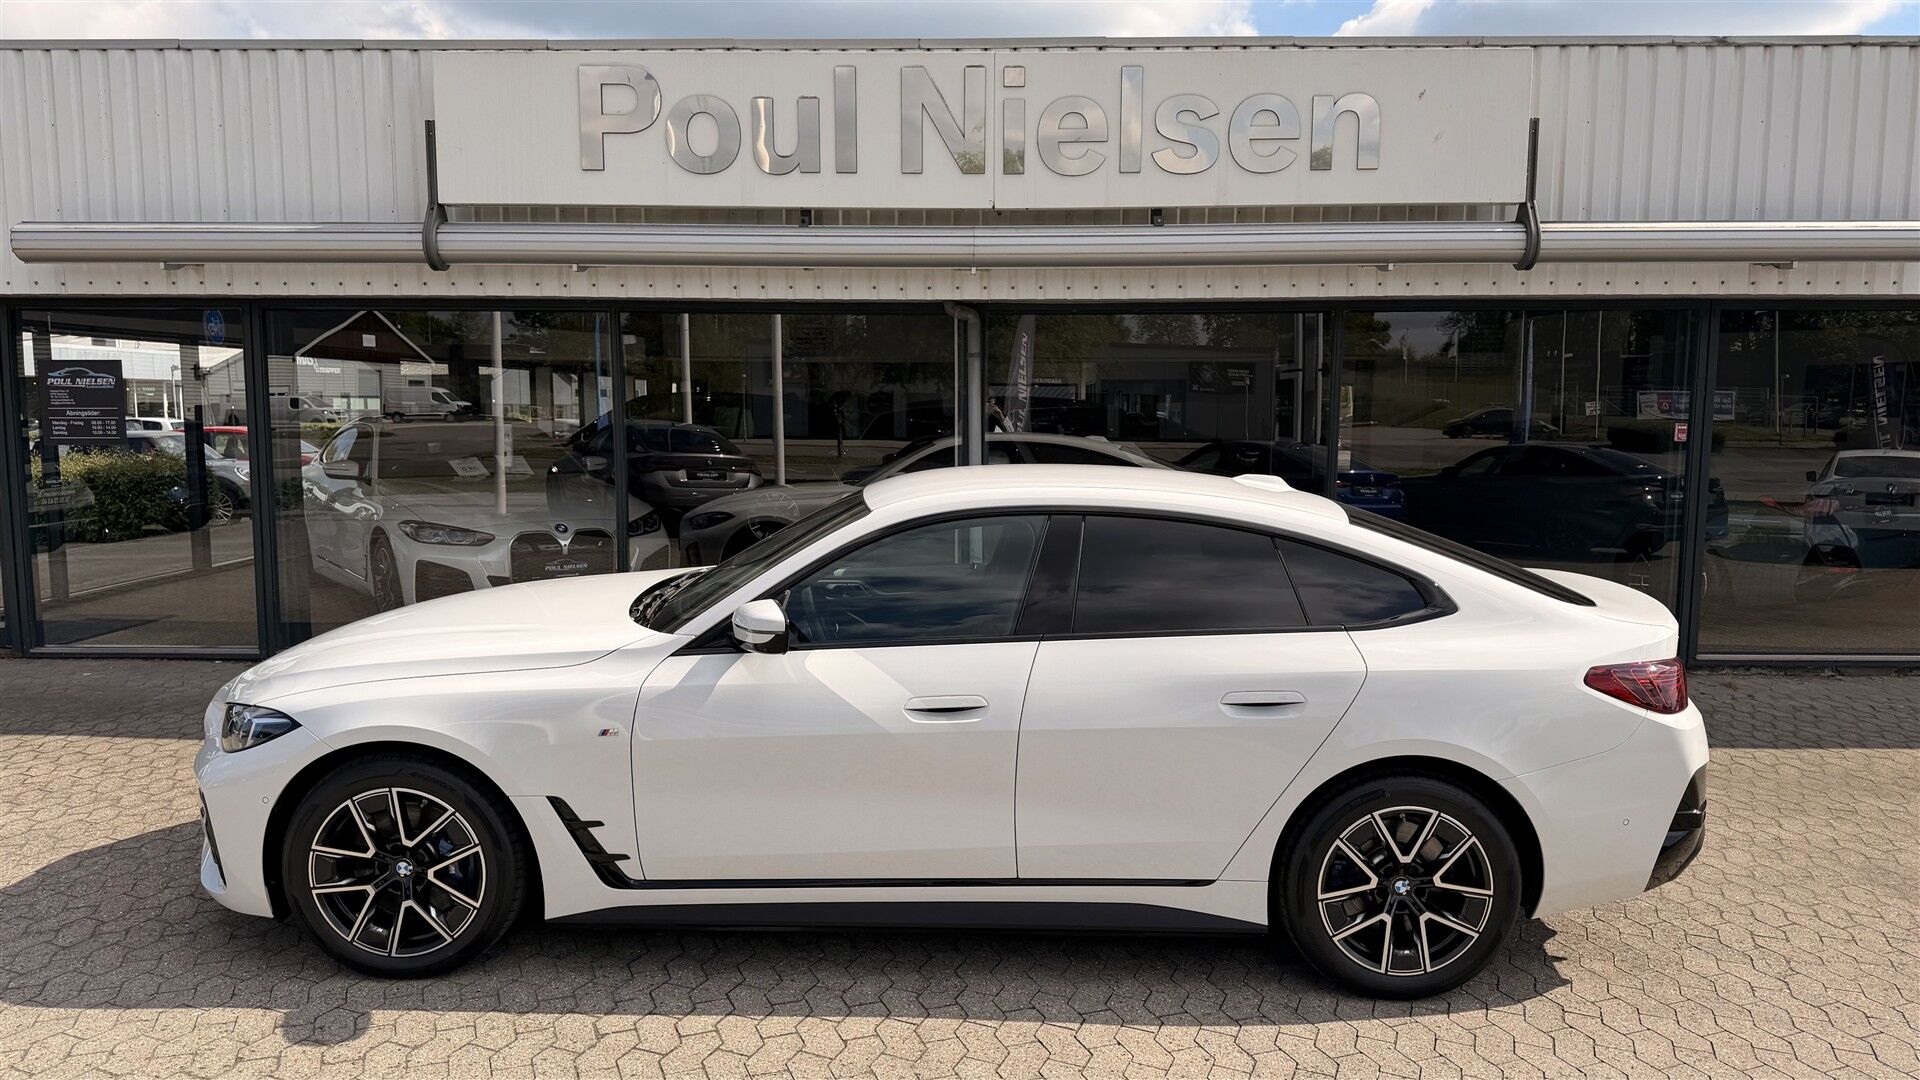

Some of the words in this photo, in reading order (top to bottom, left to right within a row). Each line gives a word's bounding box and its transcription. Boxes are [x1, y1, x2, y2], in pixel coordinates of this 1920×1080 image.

[578, 65, 857, 174] Poul
[901, 65, 1382, 176] Nielsen
[1018, 332, 1028, 403] NIELSEN
